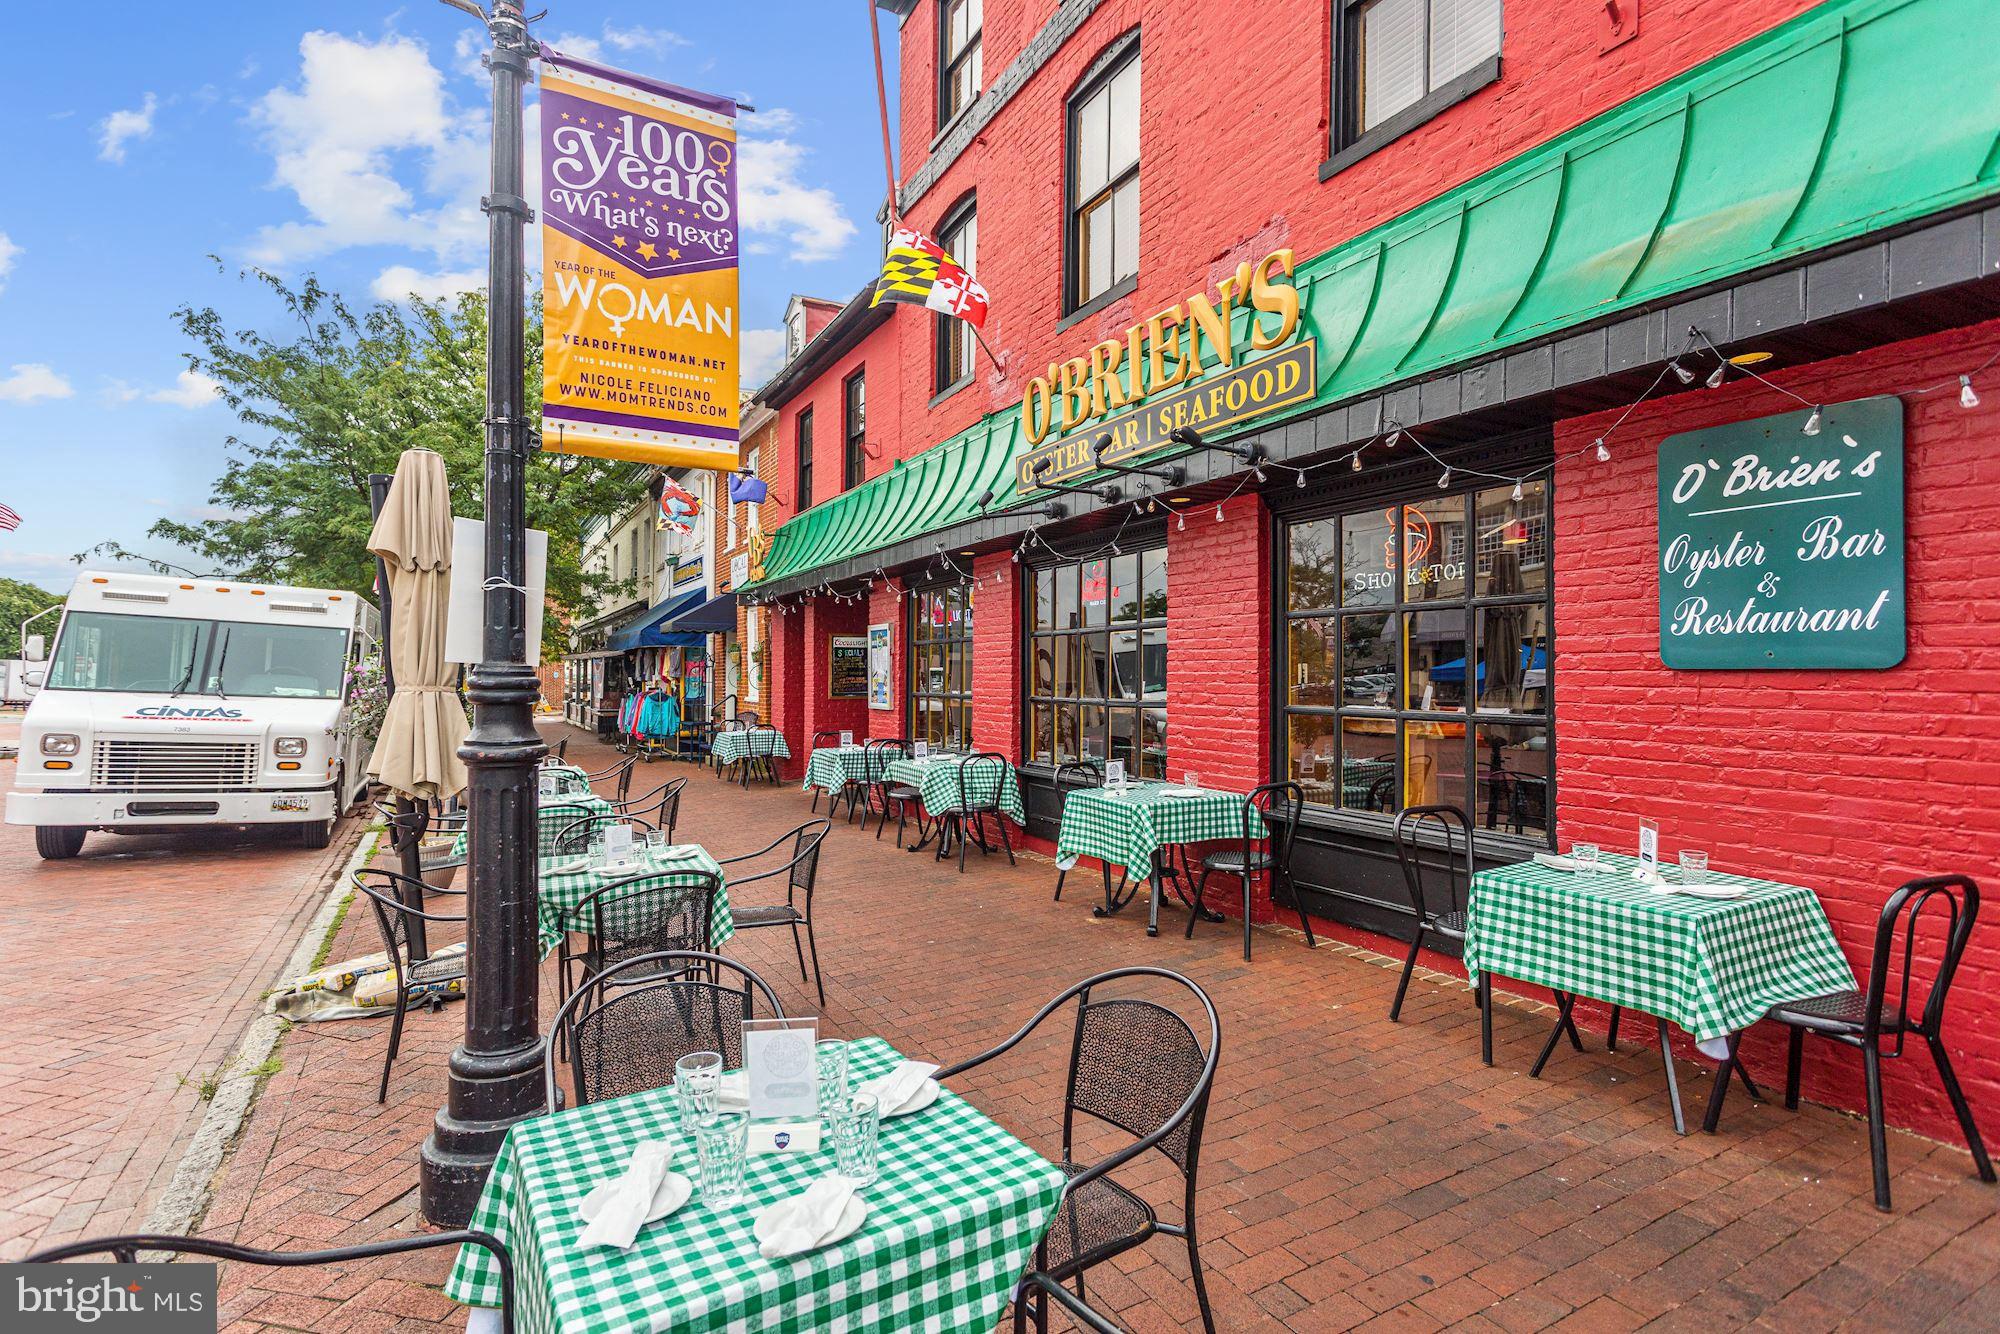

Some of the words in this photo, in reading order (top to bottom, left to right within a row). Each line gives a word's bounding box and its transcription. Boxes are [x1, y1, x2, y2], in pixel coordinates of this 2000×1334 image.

[619, 115, 705, 174] 100
[552, 126, 731, 222] Years
[550, 188, 660, 238] What's
[666, 221, 734, 255] next?
[554, 260, 580, 273] YEAR
[583, 265, 595, 275] OF
[598, 268, 616, 280] THE
[554, 272, 732, 339] WOMAN
[562, 333, 726, 371] YEAROFTHEWOMAN.NET
[1021, 248, 1300, 446] O'BRIEN'S
[573, 355, 595, 364] THIS
[651, 367, 700, 382] SPONSORED
[580, 372, 633, 391] NICOLE
[639, 381, 711, 402] FELICIANO
[559, 383, 728, 418] WWW.MOMTRENDS.COM
[1159, 359, 1302, 436] SEAFOOD
[1663, 530, 1766, 589] Oyster
[1797, 515, 1887, 562] Bar
[1354, 568, 1420, 590] SHOK
[1757, 571, 1781, 598] &
[1670, 589, 1890, 636] Restaurant
[136, 705, 242, 718] CiNTAS
